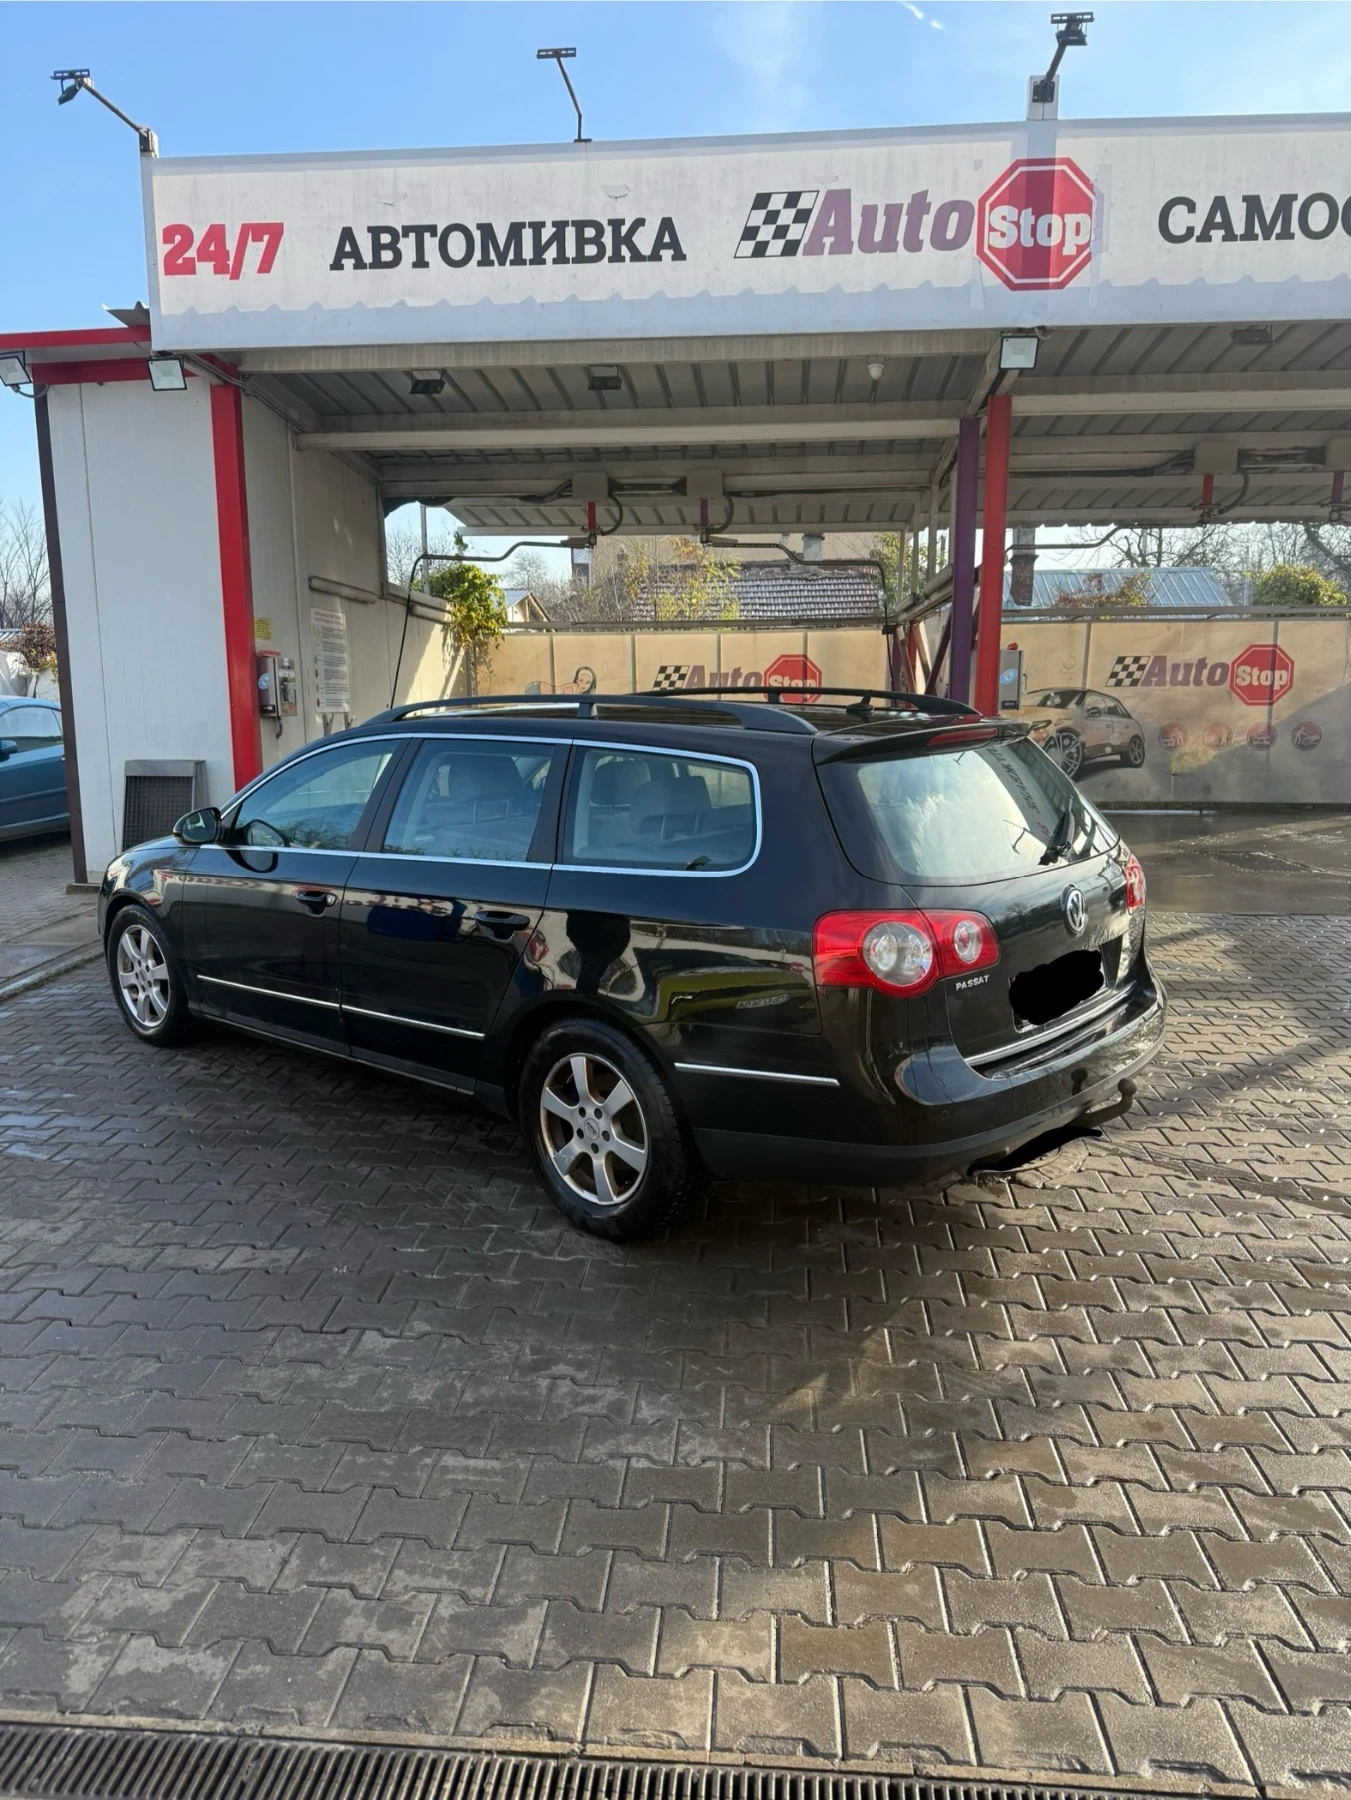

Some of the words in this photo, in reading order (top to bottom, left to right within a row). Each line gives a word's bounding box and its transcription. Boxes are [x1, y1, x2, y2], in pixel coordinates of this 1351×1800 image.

[330, 217, 686, 271] АВТОМИВКА
[802, 188, 976, 256] Auto
[988, 206, 1092, 256] Stop
[1158, 192, 1351, 244] САМО
[163, 223, 284, 280] 24/7
[685, 665, 763, 688] Auto
[1140, 656, 1230, 687] Auto
[1236, 666, 1289, 691] Stop
[956, 975, 990, 992] PASSAT
